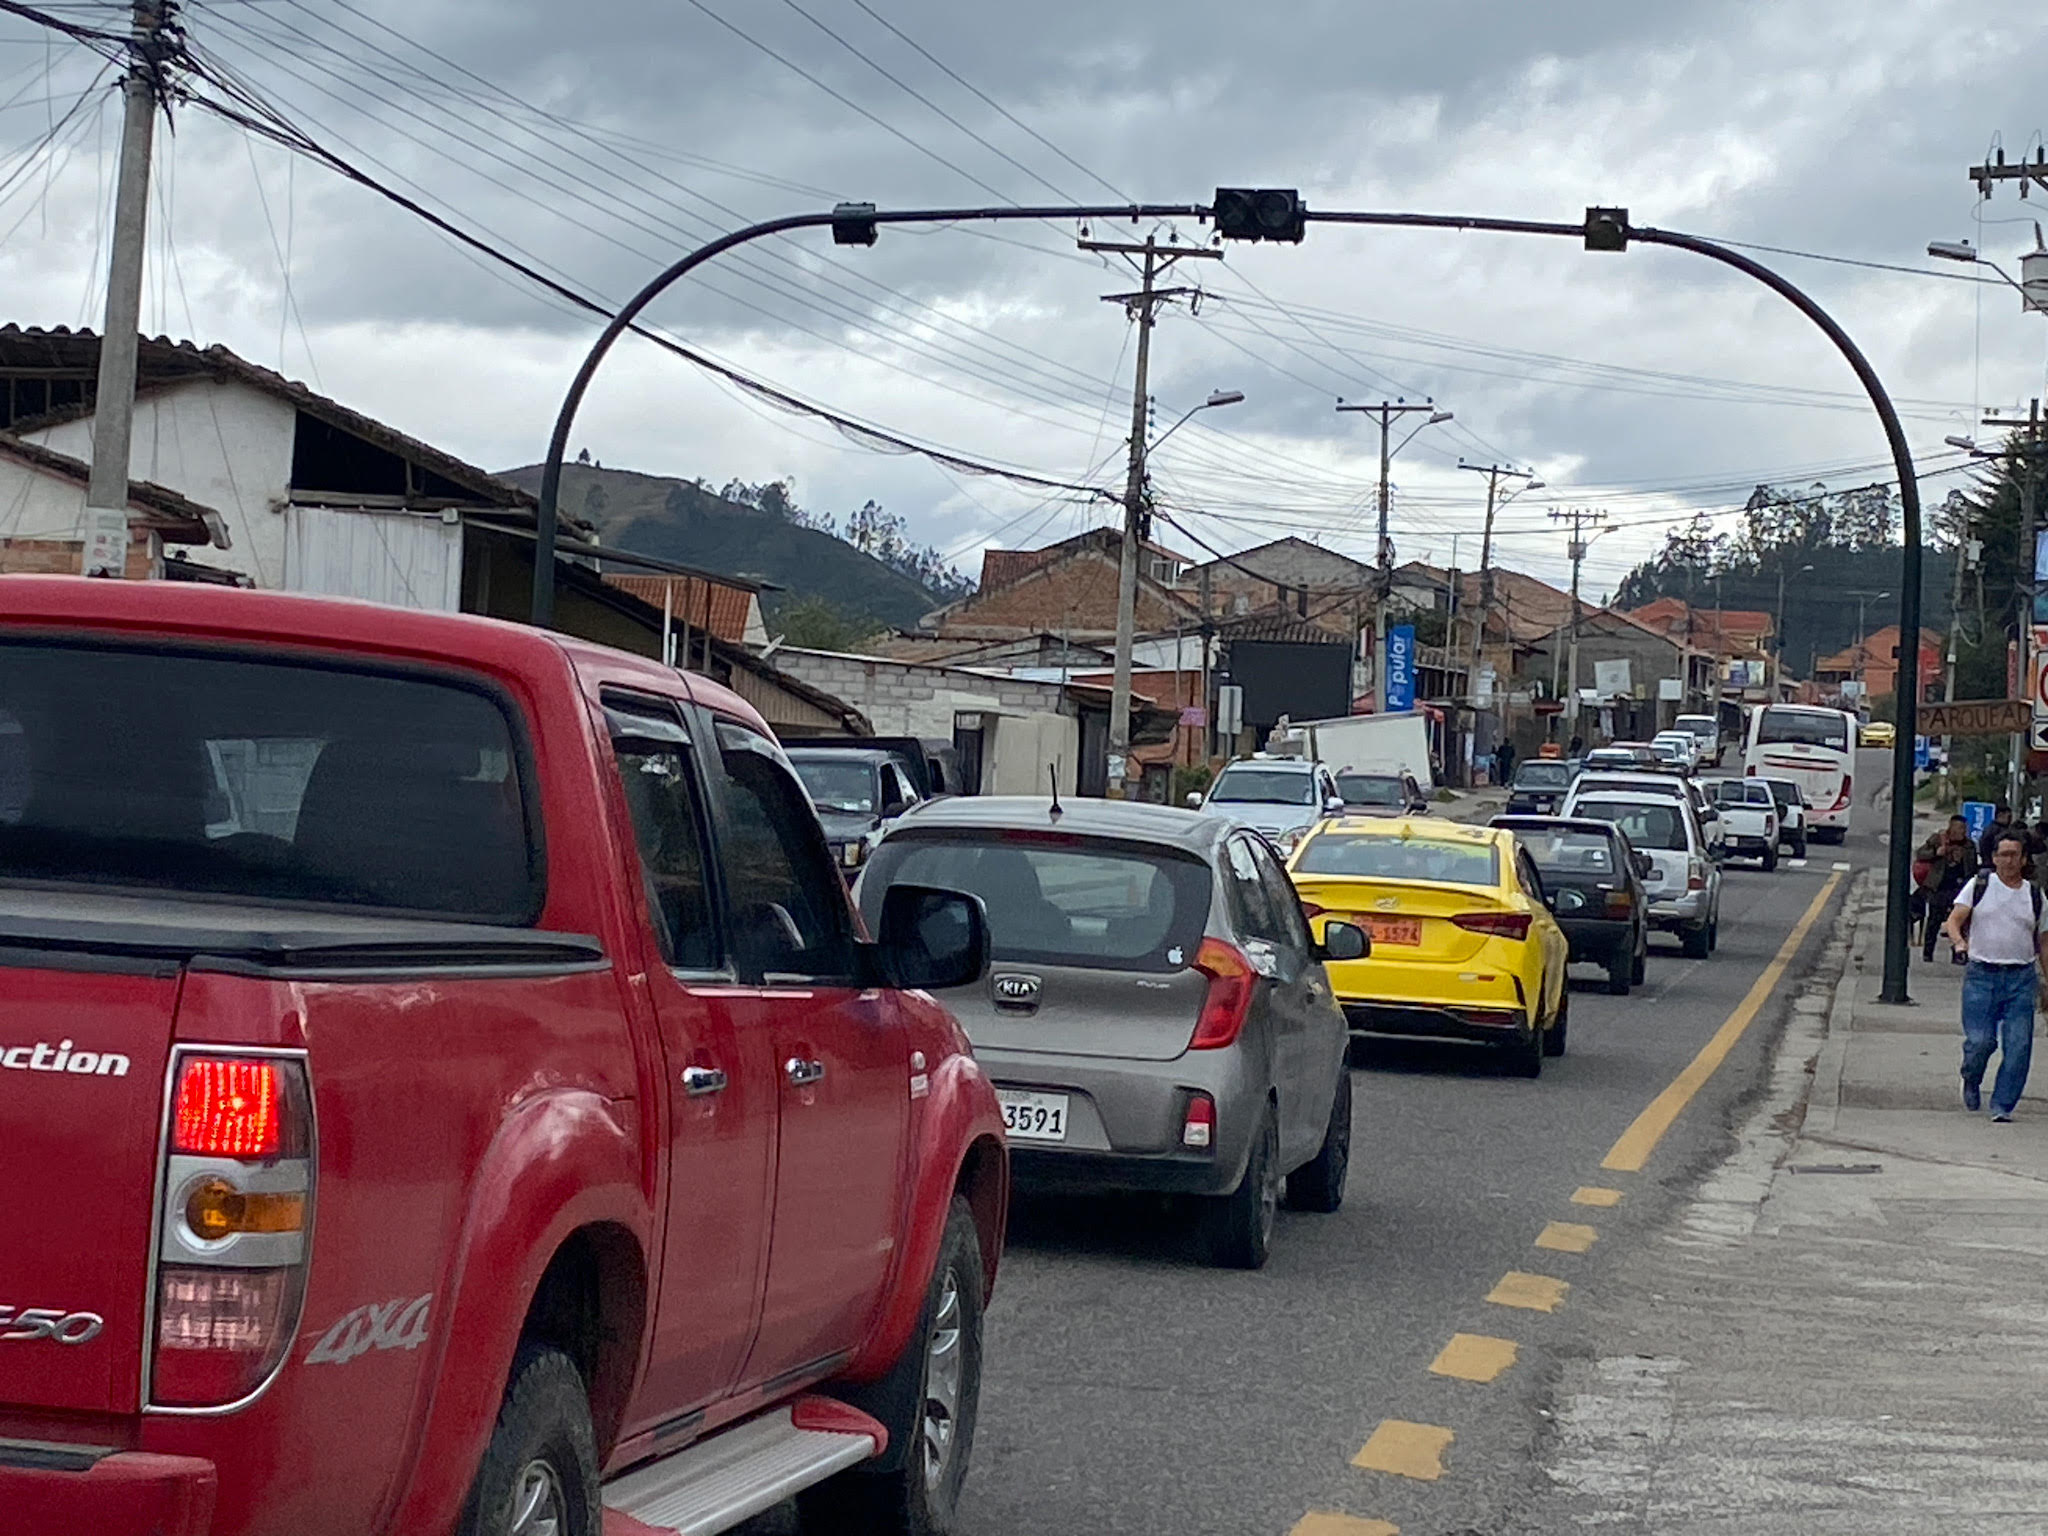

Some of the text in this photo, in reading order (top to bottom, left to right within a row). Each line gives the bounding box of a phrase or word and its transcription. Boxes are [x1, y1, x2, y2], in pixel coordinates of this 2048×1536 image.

[1003, 980, 1031, 994] KIA
[0, 1039, 130, 1076] ction
[1004, 1104, 1062, 1134] 3591
